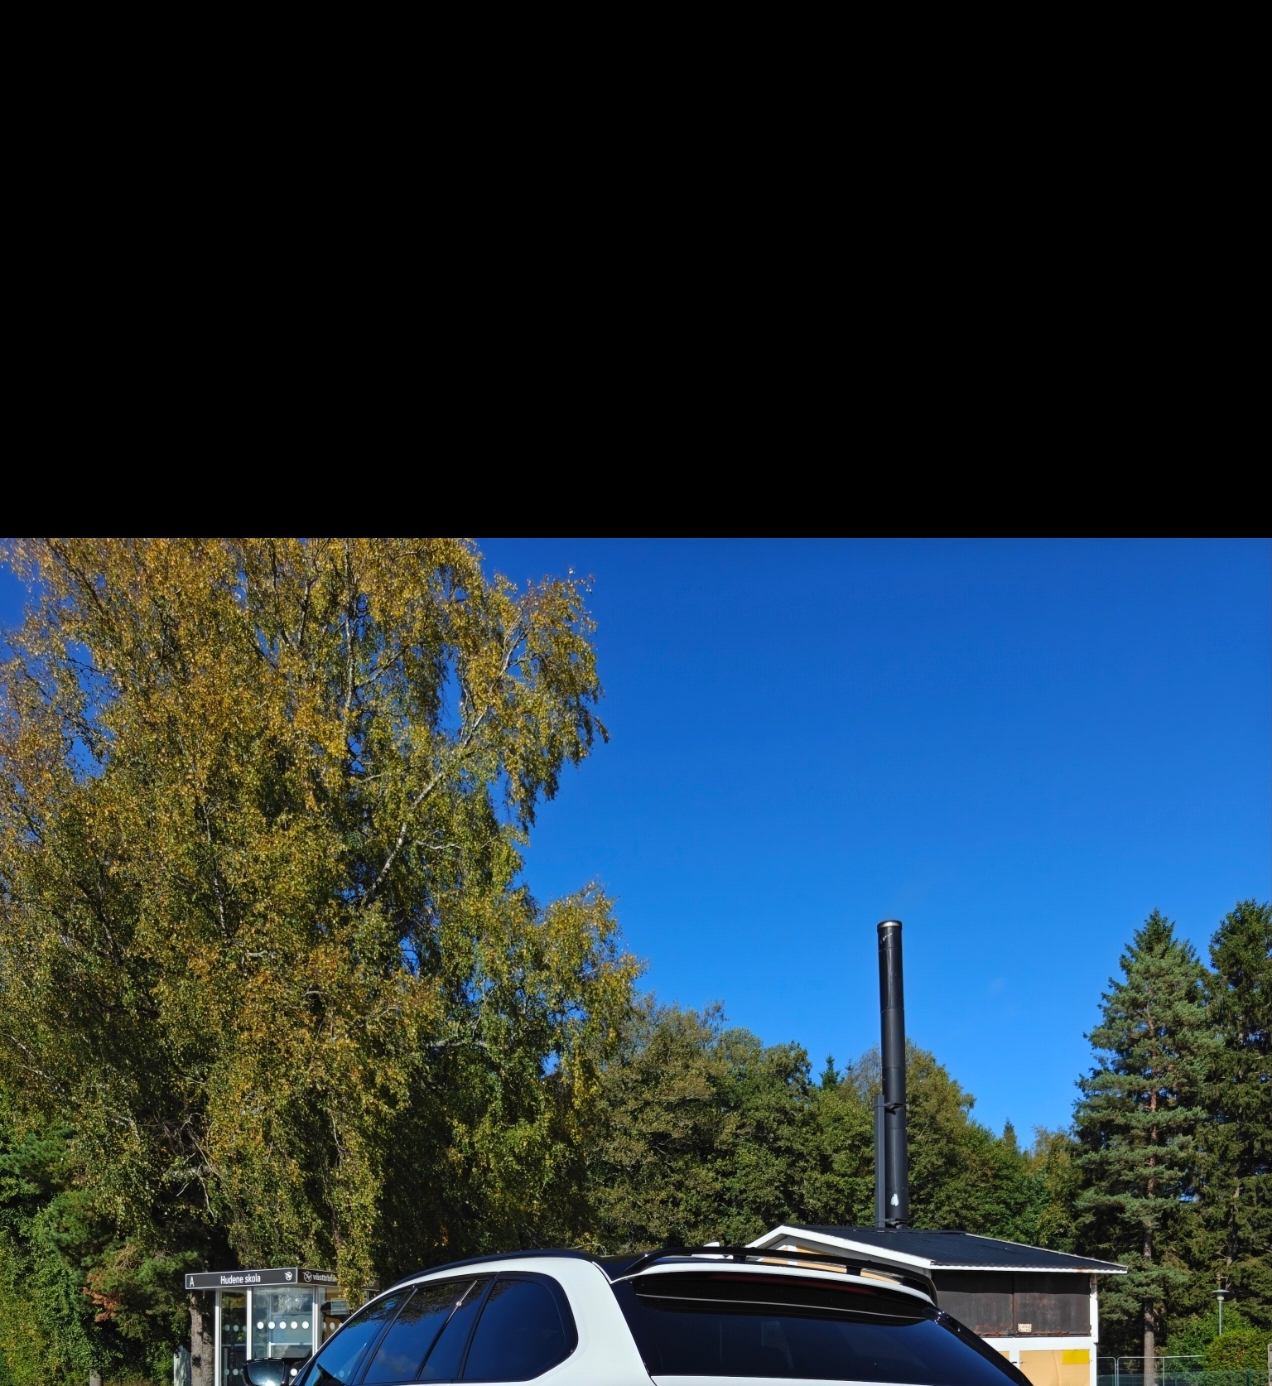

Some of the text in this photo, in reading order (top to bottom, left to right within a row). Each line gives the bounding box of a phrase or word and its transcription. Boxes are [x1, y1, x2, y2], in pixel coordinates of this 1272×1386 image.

[189, 1276, 195, 1287] A
[220, 1273, 261, 1285] Hudene skola
